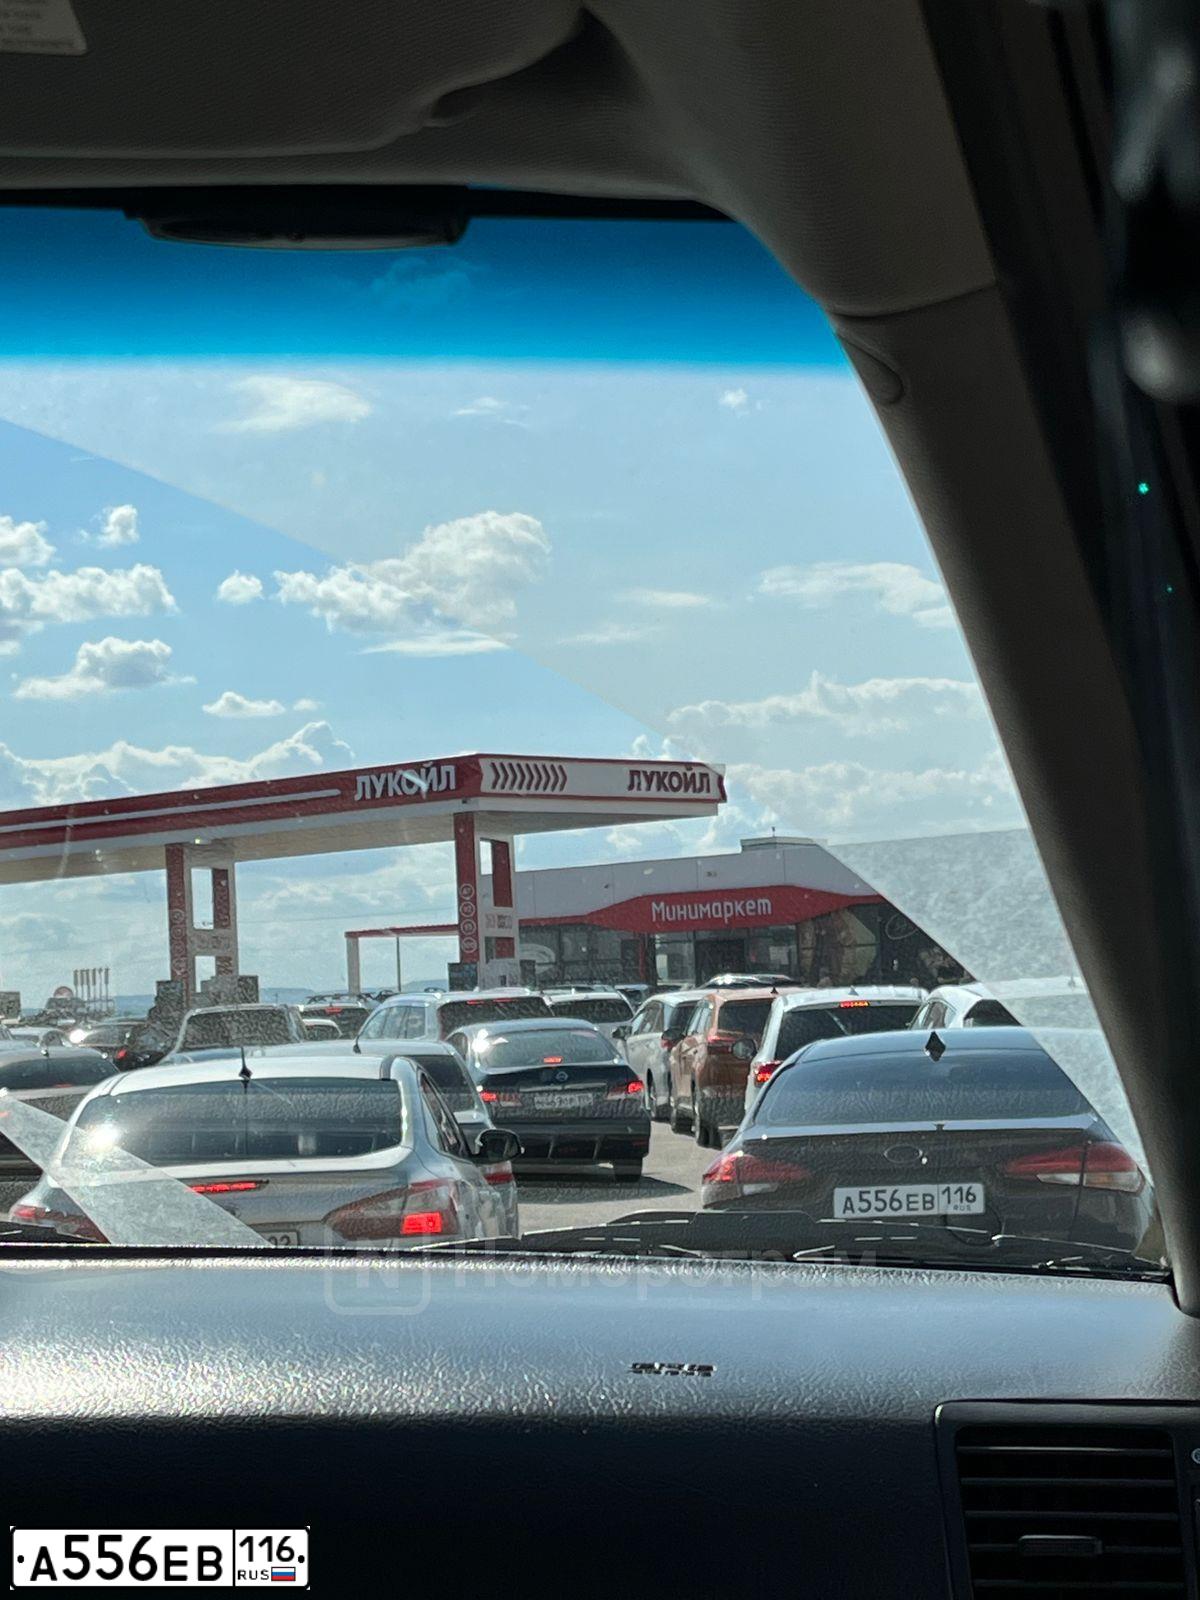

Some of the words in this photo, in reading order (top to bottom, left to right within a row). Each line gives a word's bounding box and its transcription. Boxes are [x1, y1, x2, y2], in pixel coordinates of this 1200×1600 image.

[354, 761, 456, 801] ЛУКОЙЛ
[627, 764, 711, 794] ЛУКОЙЛ
[651, 898, 772, 924] Минимаркет
[842, 1188, 935, 1214] А556ЕВ
[941, 1186, 977, 1205] 116
